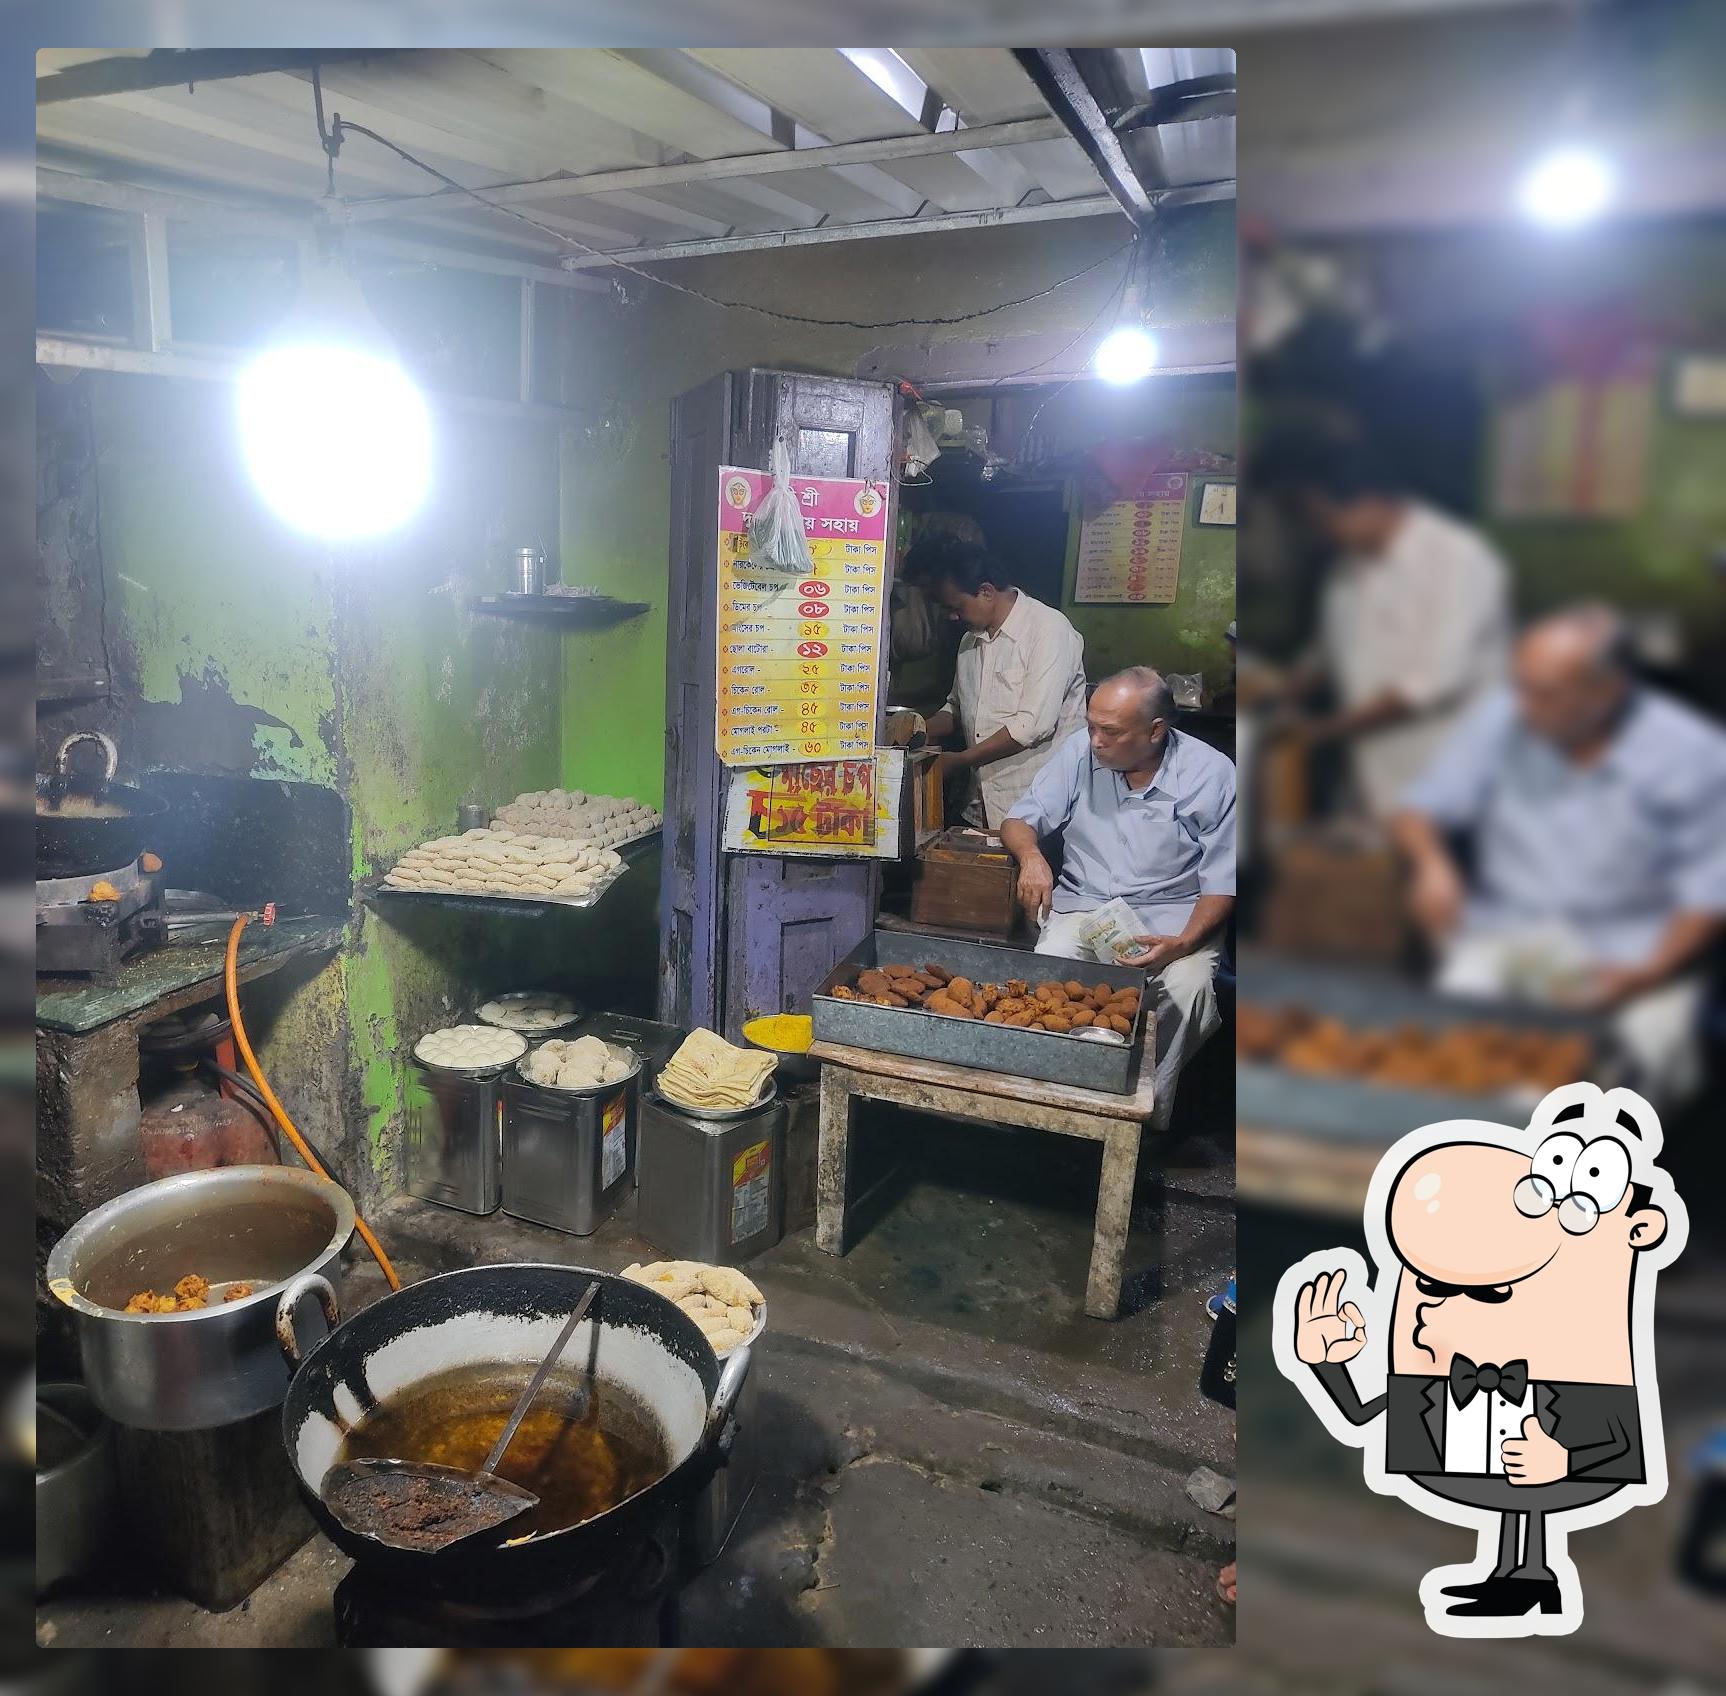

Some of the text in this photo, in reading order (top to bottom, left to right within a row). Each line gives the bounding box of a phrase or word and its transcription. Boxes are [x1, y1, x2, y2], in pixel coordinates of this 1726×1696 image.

[801, 487, 820, 507] শ্রী
[820, 517, 859, 534] সহায়
[845, 543, 877, 555] টাকা পিস
[845, 563, 860, 575] টাকা
[863, 563, 876, 575] পিস
[804, 584, 826, 595] ০৬
[844, 584, 860, 595] টাকা
[862, 584, 876, 596] পিস
[804, 604, 826, 614] ০৮
[844, 604, 860, 614] টাকা
[862, 603, 875, 615] পিস
[843, 623, 858, 634] টাকা
[860, 623, 874, 635] পিস
[802, 645, 825, 656] ১২
[841, 645, 857, 655] টাকা
[858, 644, 872, 655] পিস
[840, 663, 856, 674] টাকা
[857, 662, 871, 674] পিস
[840, 683, 855, 693] টাকা
[857, 681, 870, 694] পিস
[840, 702, 855, 712] টাকা
[856, 701, 870, 713] পিস
[840, 721, 855, 731] টাকা
[856, 720, 869, 731] পিস
[840, 740, 854, 750] টাকা
[856, 739, 869, 750] পিস
